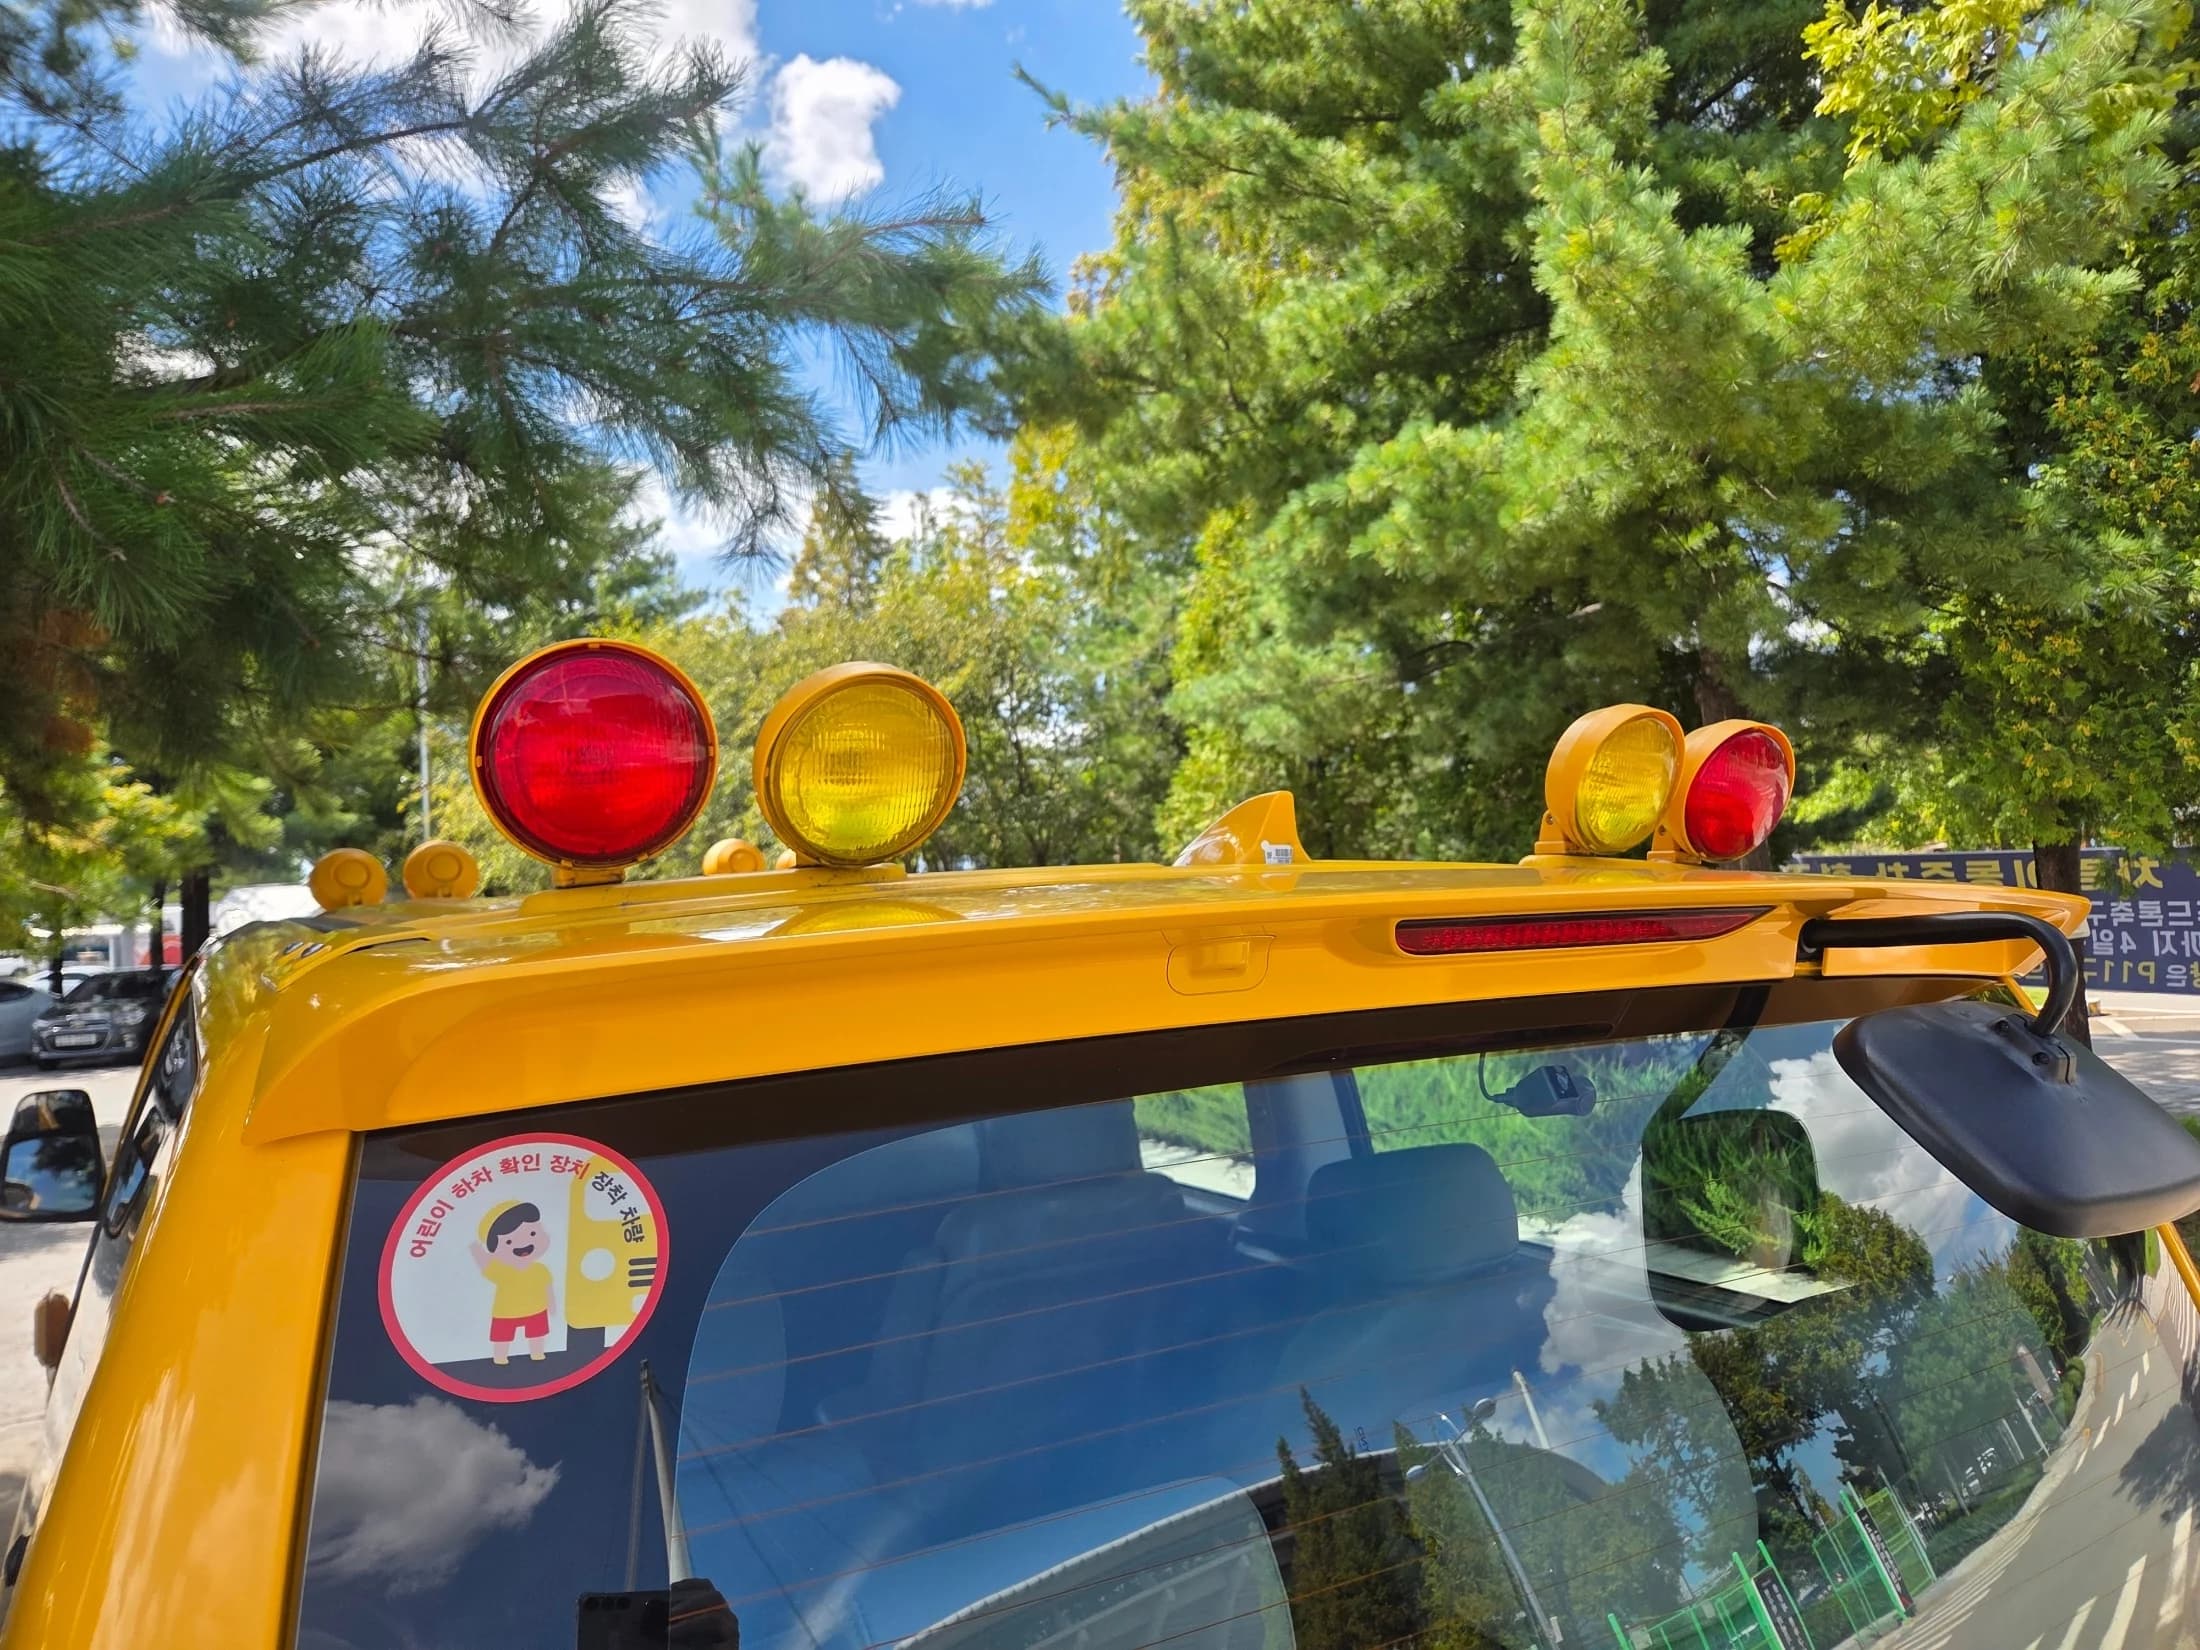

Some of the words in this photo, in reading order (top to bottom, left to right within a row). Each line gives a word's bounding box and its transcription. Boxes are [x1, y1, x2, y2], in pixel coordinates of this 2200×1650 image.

[409, 1199, 455, 1258] 어린이
[451, 1166, 494, 1199] 하차
[500, 1153, 541, 1175] 확인
[550, 1155, 591, 1180] 장치
[591, 1171, 628, 1206] 장착
[620, 1206, 646, 1243] 차량
